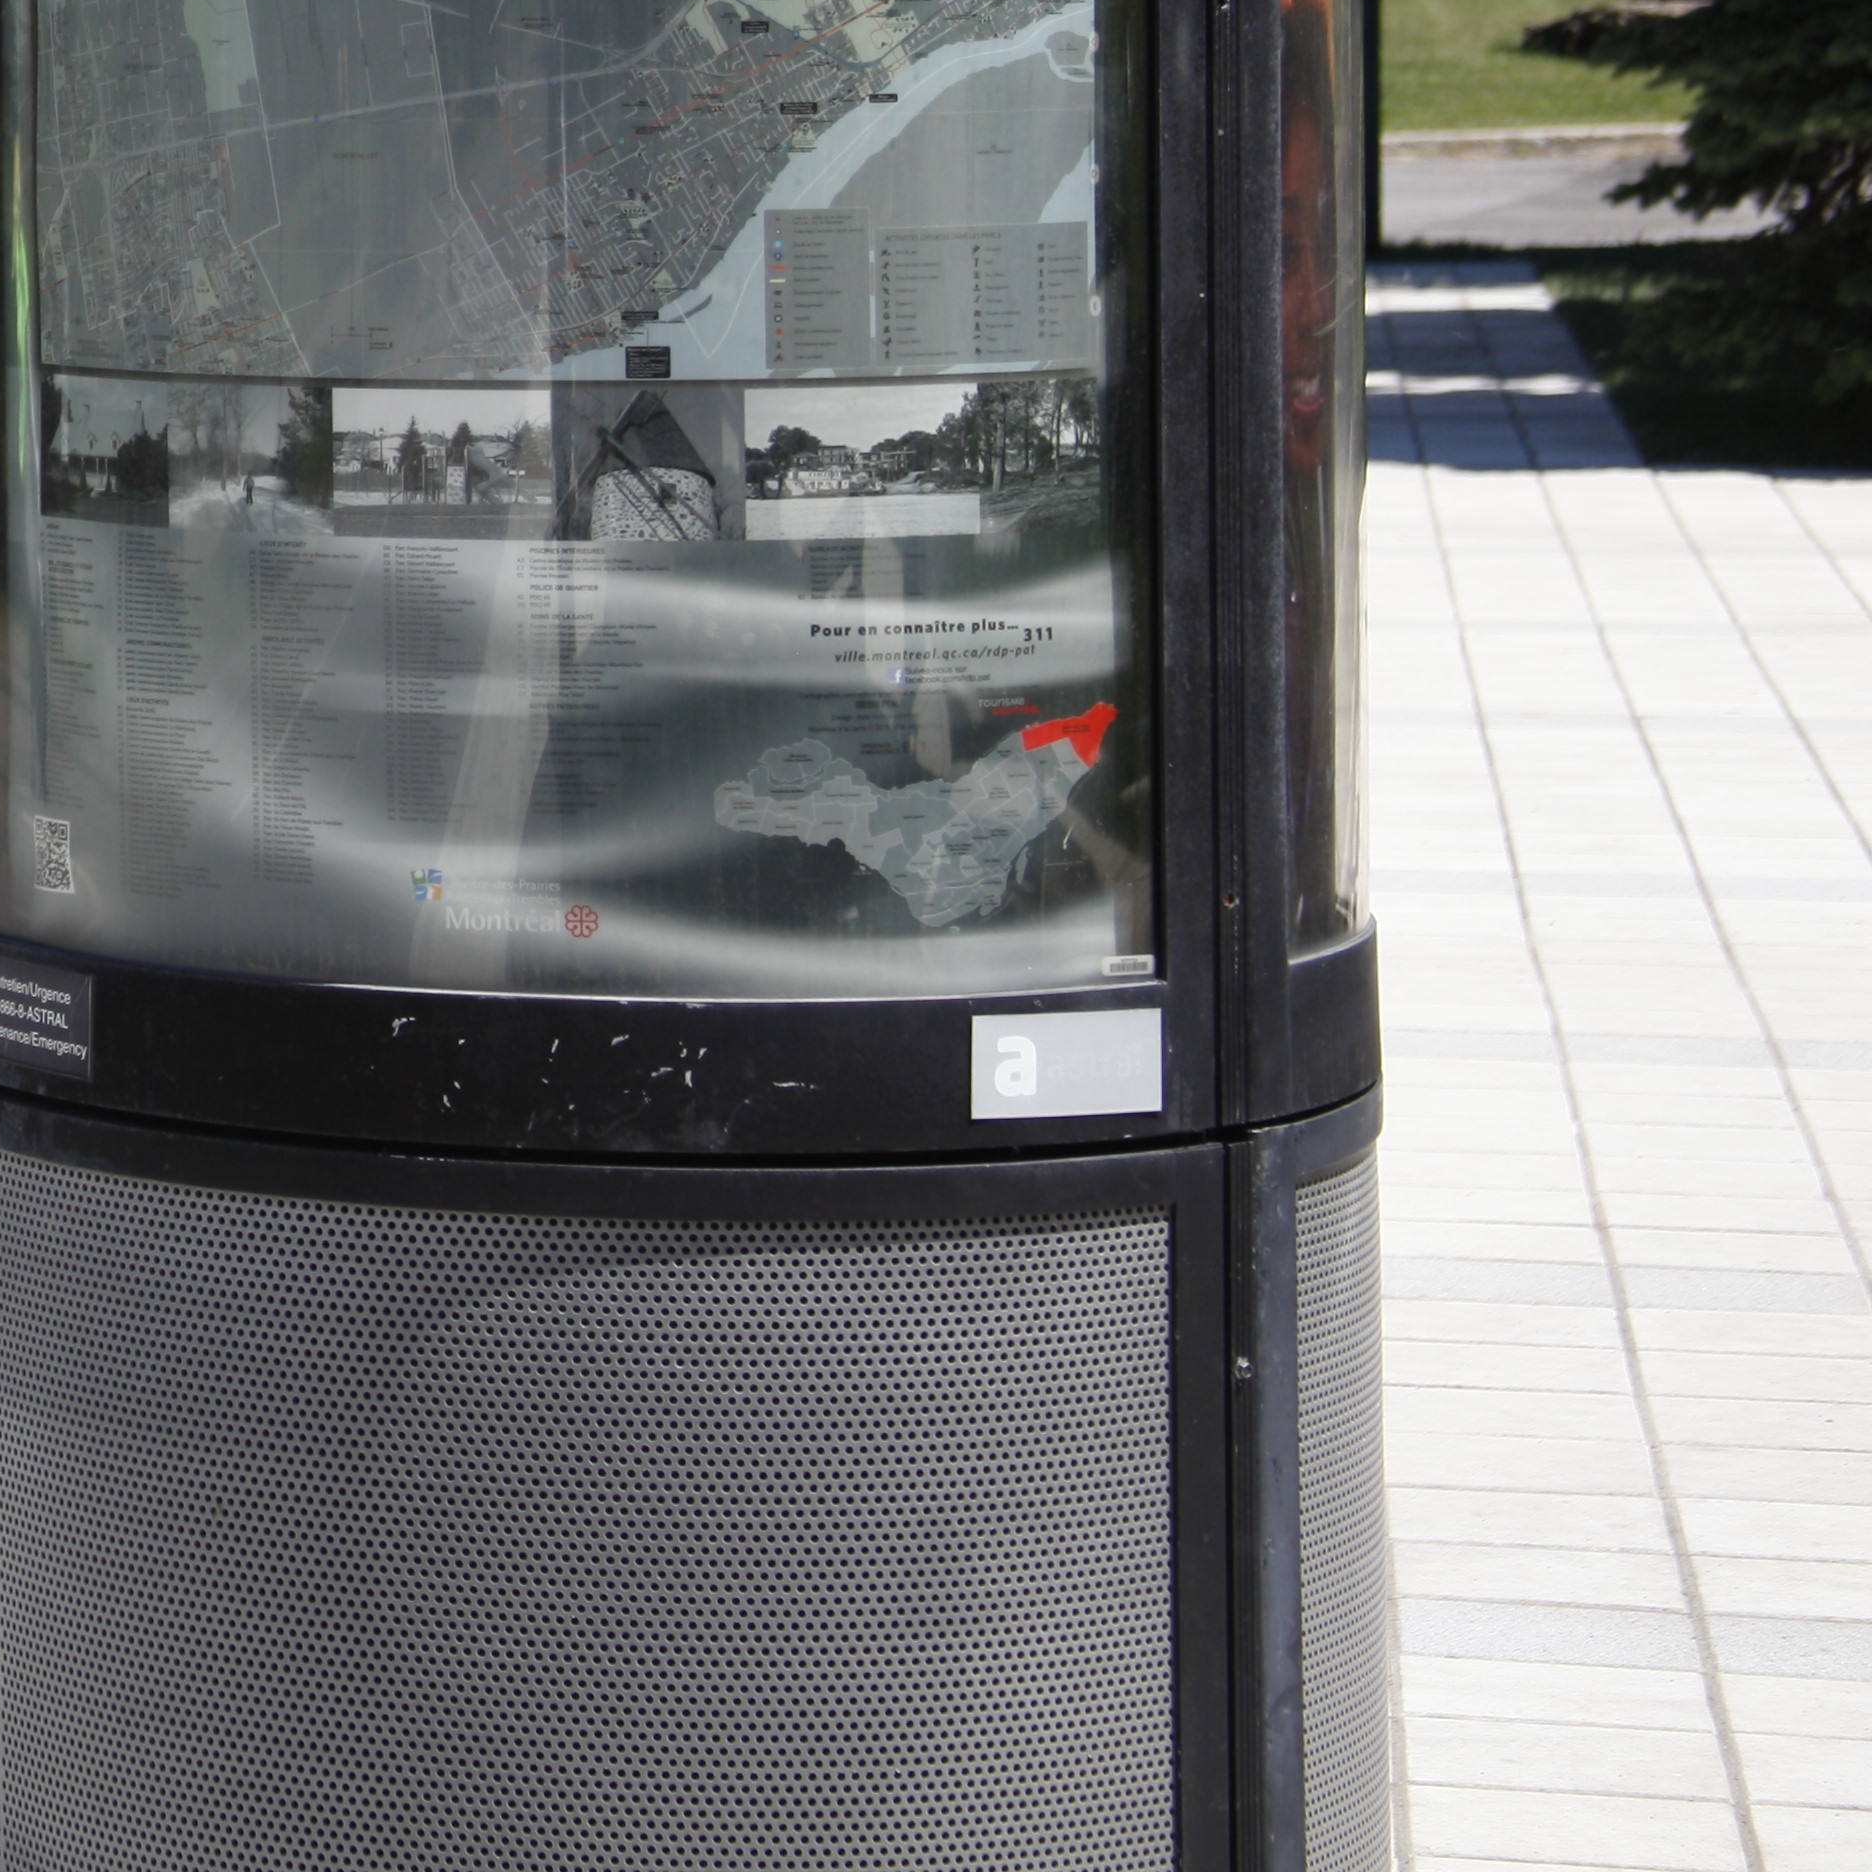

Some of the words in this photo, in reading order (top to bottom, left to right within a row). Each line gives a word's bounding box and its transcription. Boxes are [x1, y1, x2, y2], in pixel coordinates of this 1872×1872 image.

[810, 624, 852, 638] Pour
[857, 625, 878, 636] en
[884, 619, 966, 636] connaître
[1022, 627, 1055, 642] 311
[834, 644, 1037, 663] ville.montreal.qc.ca/rdp-pat
[452, 879, 561, 892] vière-des-Prairies
[445, 905, 561, 934] Montréal
